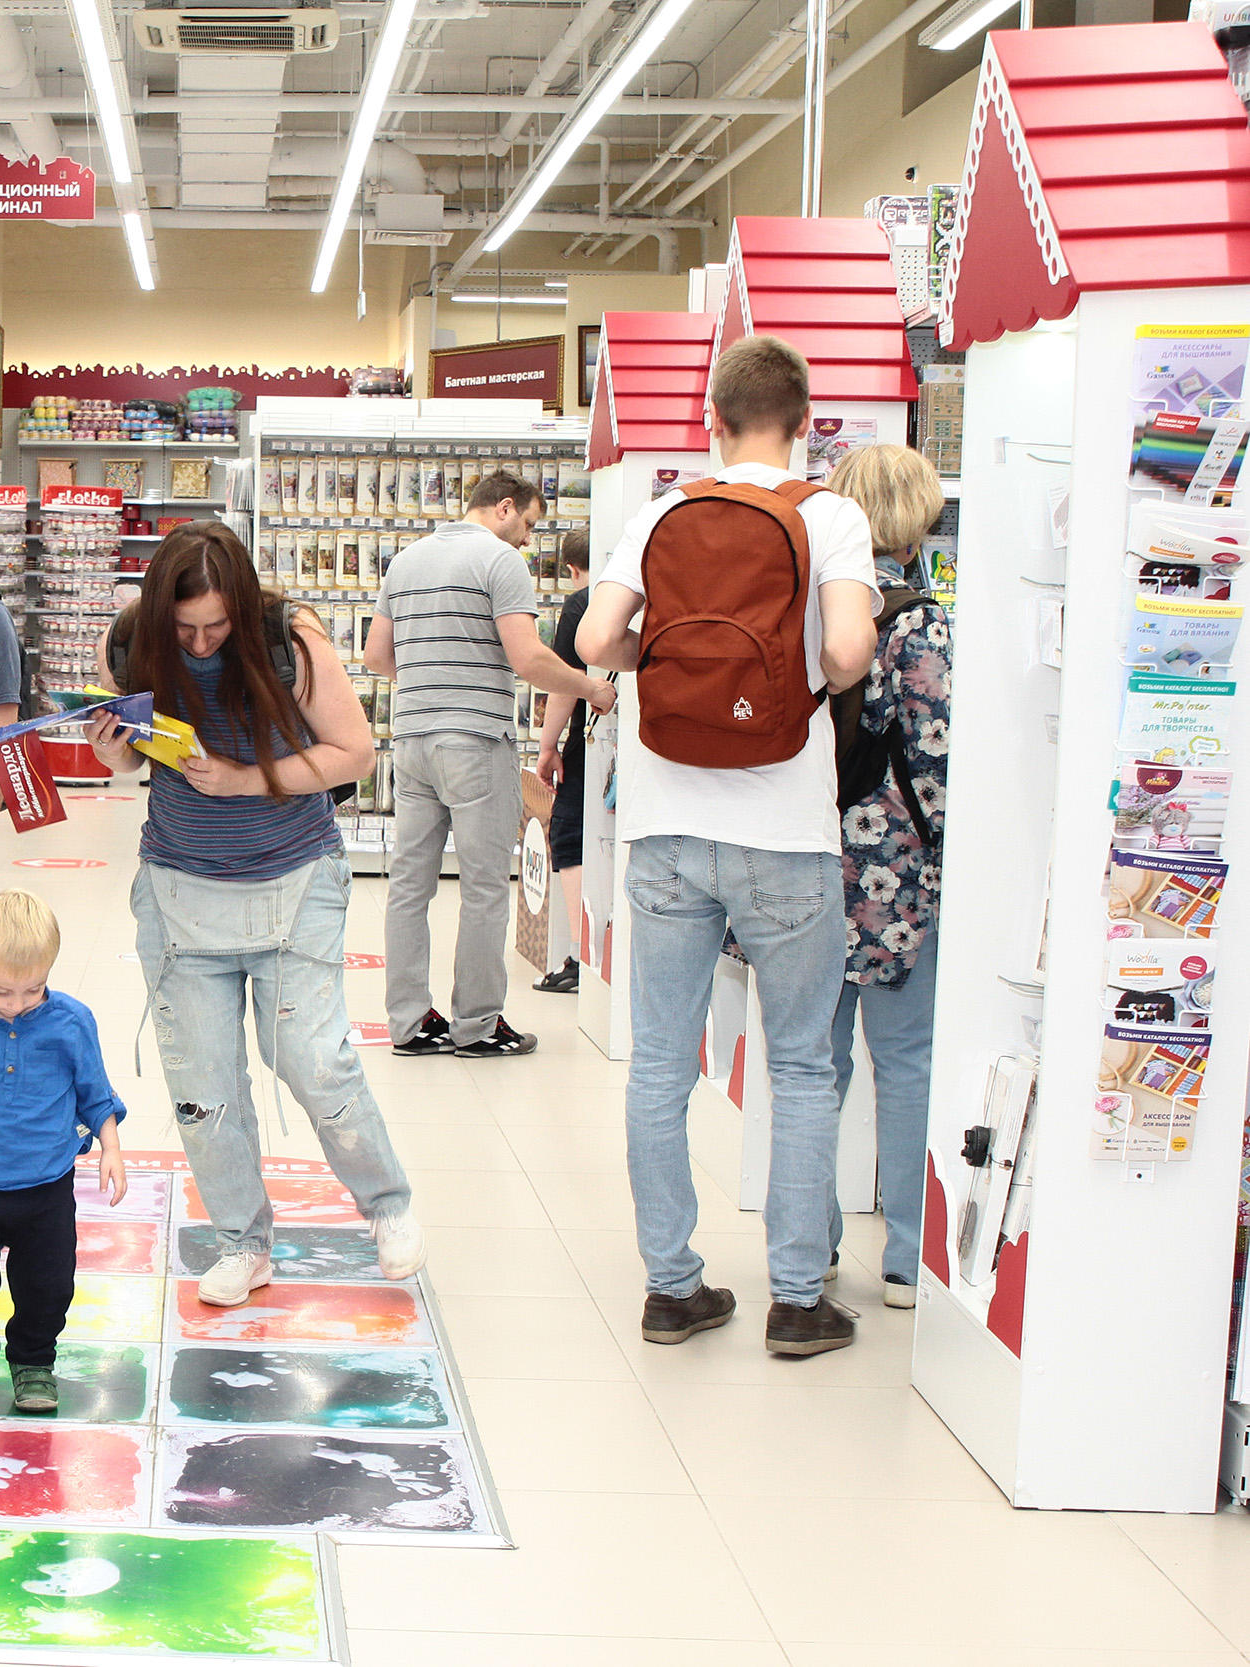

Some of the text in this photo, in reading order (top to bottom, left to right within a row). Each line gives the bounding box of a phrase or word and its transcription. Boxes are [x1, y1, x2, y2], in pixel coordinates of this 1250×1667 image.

[444, 370, 545, 388] Багетная мастерская
[1184, 622, 1220, 630] ТОВАРЫ
[1162, 716, 1196, 724] ТОВАРЫ
[1141, 724, 1214, 732] ДЛЯ ТВОРЧЕСТВА
[0, 744, 36, 822] Леонардо
[1133, 859, 1221, 874] ВОЗЬМИ КАТАЛОГ БЕСПЛАТНО!
